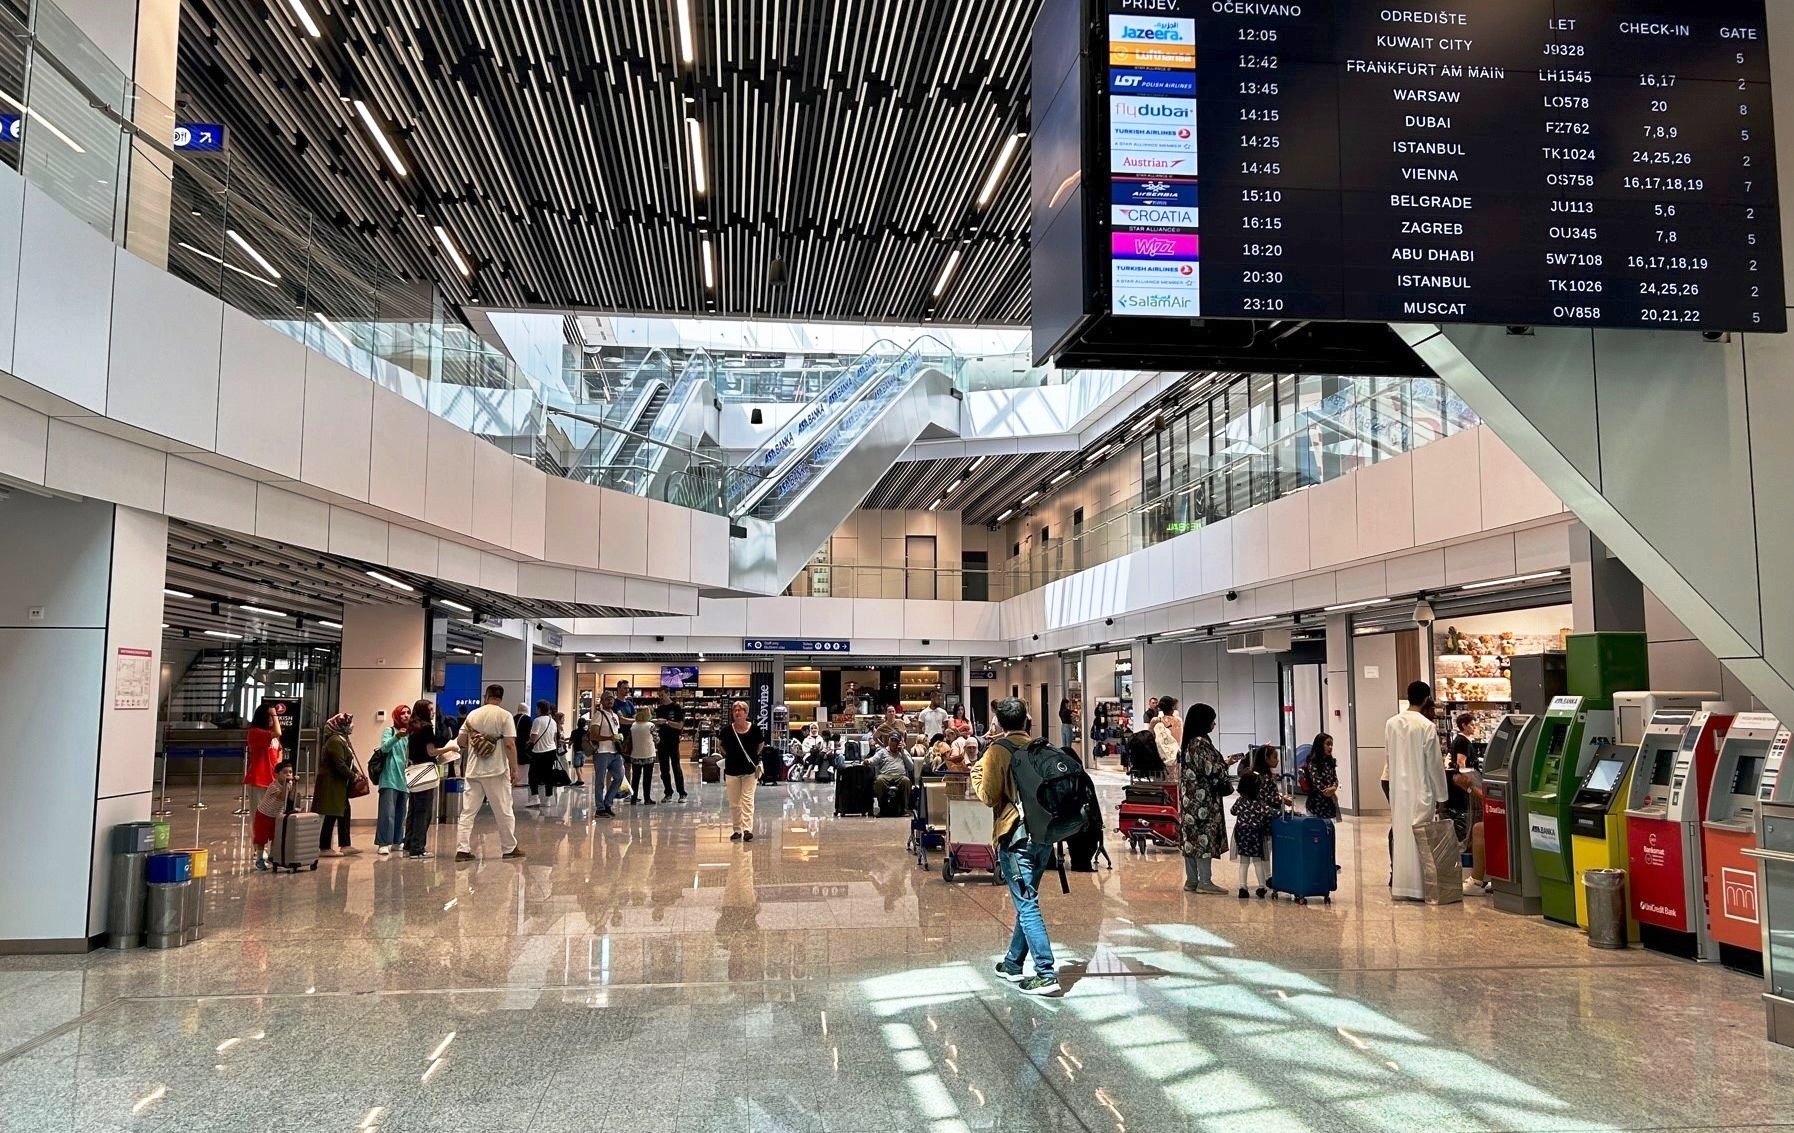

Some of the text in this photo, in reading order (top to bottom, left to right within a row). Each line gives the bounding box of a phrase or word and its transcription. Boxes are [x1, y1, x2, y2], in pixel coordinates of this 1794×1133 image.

[1212, 0, 1300, 16] OČEKIVANO
[1381, 9, 1467, 25] ODREDIŠTE
[1550, 19, 1575, 29] LET
[1620, 23, 1688, 35] CHECK-IN
[1239, 29, 1276, 41] 12:05
[1720, 28, 1756, 39] GATE
[1378, 36, 1472, 50] KUWAIT CITY
[1544, 44, 1584, 56] J9328
[1240, 55, 1277, 68] 12:42
[1737, 53, 1743, 63] 5
[1347, 60, 1503, 78] FRANKFURT AM MAIN
[1114, 75, 1142, 86] LOT
[1540, 70, 1591, 82] LH1545
[1640, 74, 1675, 87] 16,17
[1240, 83, 1278, 94] 13:45
[1739, 79, 1745, 89] 2
[1394, 89, 1460, 102] WARSAW
[1545, 96, 1588, 108] LO578
[1652, 101, 1667, 111] 20
[1241, 109, 1278, 121] 14:15
[1740, 105, 1747, 115] 8
[1406, 116, 1450, 128] DUBAI
[1546, 122, 1589, 134] FZ762
[1644, 126, 1677, 138] 7,8,9
[1742, 130, 1748, 140] 5
[1241, 136, 1279, 147] 14:25
[1394, 142, 1465, 155] ISTANBUL
[1543, 148, 1595, 160] TK1024
[1123, 157, 1168, 168] Austrian
[1633, 152, 1691, 164] 24,25,26
[1743, 156, 1750, 166] 2
[1242, 163, 1280, 174] 14:45
[1402, 168, 1458, 181] VIENNA
[1547, 174, 1593, 186] OS758
[1624, 177, 1703, 190] 16,17,18,19
[1745, 182, 1751, 192] 7
[1243, 190, 1281, 202] 15:10
[1391, 195, 1472, 208] BELGRADE
[1551, 201, 1593, 212] JU113
[1655, 205, 1675, 216] 5,6
[1128, 209, 1192, 222] CROATIA
[1747, 208, 1754, 218] 2
[1243, 217, 1281, 229] 16:15
[1402, 222, 1462, 234] ZAGREB
[1550, 227, 1596, 239] OU345
[1656, 231, 1676, 243] 7,8
[1749, 234, 1755, 244] 5
[1244, 244, 1282, 256] 18:20
[1392, 249, 1473, 261] ABU DHABI
[1547, 254, 1602, 265] 5W7108
[1629, 256, 1707, 270] 16,17,18,19
[1750, 260, 1757, 270] 2
[1244, 271, 1282, 283] 20:30
[1398, 275, 1471, 288] ISTANBUL
[1549, 280, 1602, 292] TK1026
[1640, 283, 1698, 295] 24,25,26
[1752, 287, 1758, 296] 2
[1129, 296, 1192, 308] SalamAir
[1244, 299, 1283, 310] 23:10
[1405, 303, 1466, 314] MUSCAT
[1554, 307, 1600, 318] OV858
[1642, 309, 1699, 322] 20,21,22
[1753, 313, 1760, 322] 5
[837, 378, 852, 397] BANKA
[808, 404, 825, 424] BANKA
[765, 432, 794, 464] ASA BANKA
[1590, 736, 1610, 745] ASA
[1540, 827, 1555, 836] BANKA
[1645, 902, 1677, 917] UniCredit Bank
